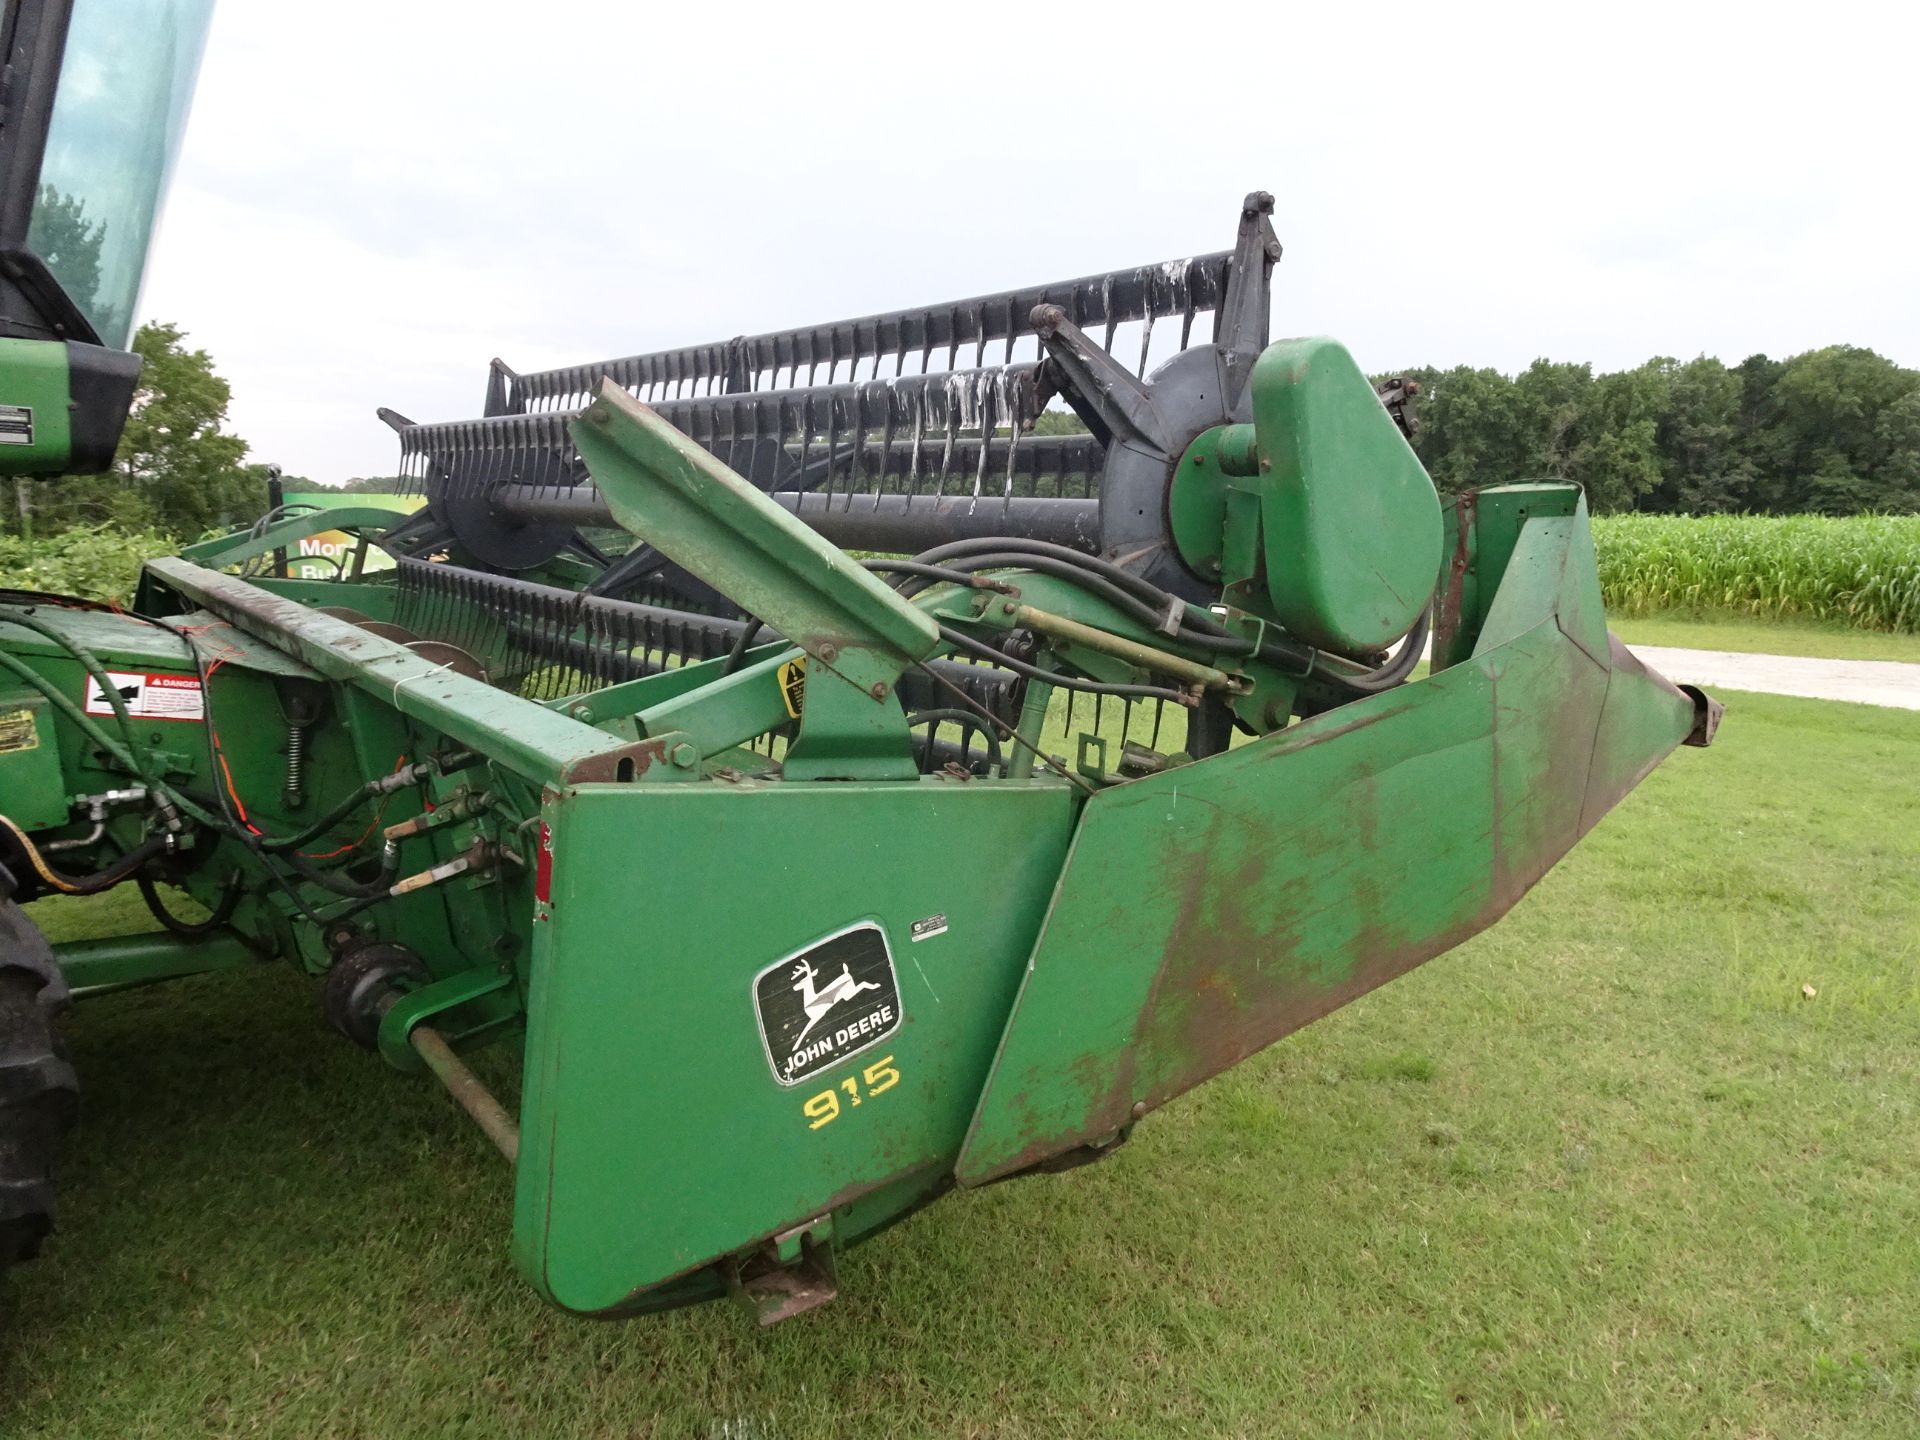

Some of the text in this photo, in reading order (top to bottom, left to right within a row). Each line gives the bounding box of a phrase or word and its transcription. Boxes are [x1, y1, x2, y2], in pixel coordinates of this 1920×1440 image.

[163, 679, 201, 688] DANGER
[784, 1005, 893, 1073] JOHN DEERE
[803, 1055, 900, 1131] 915
